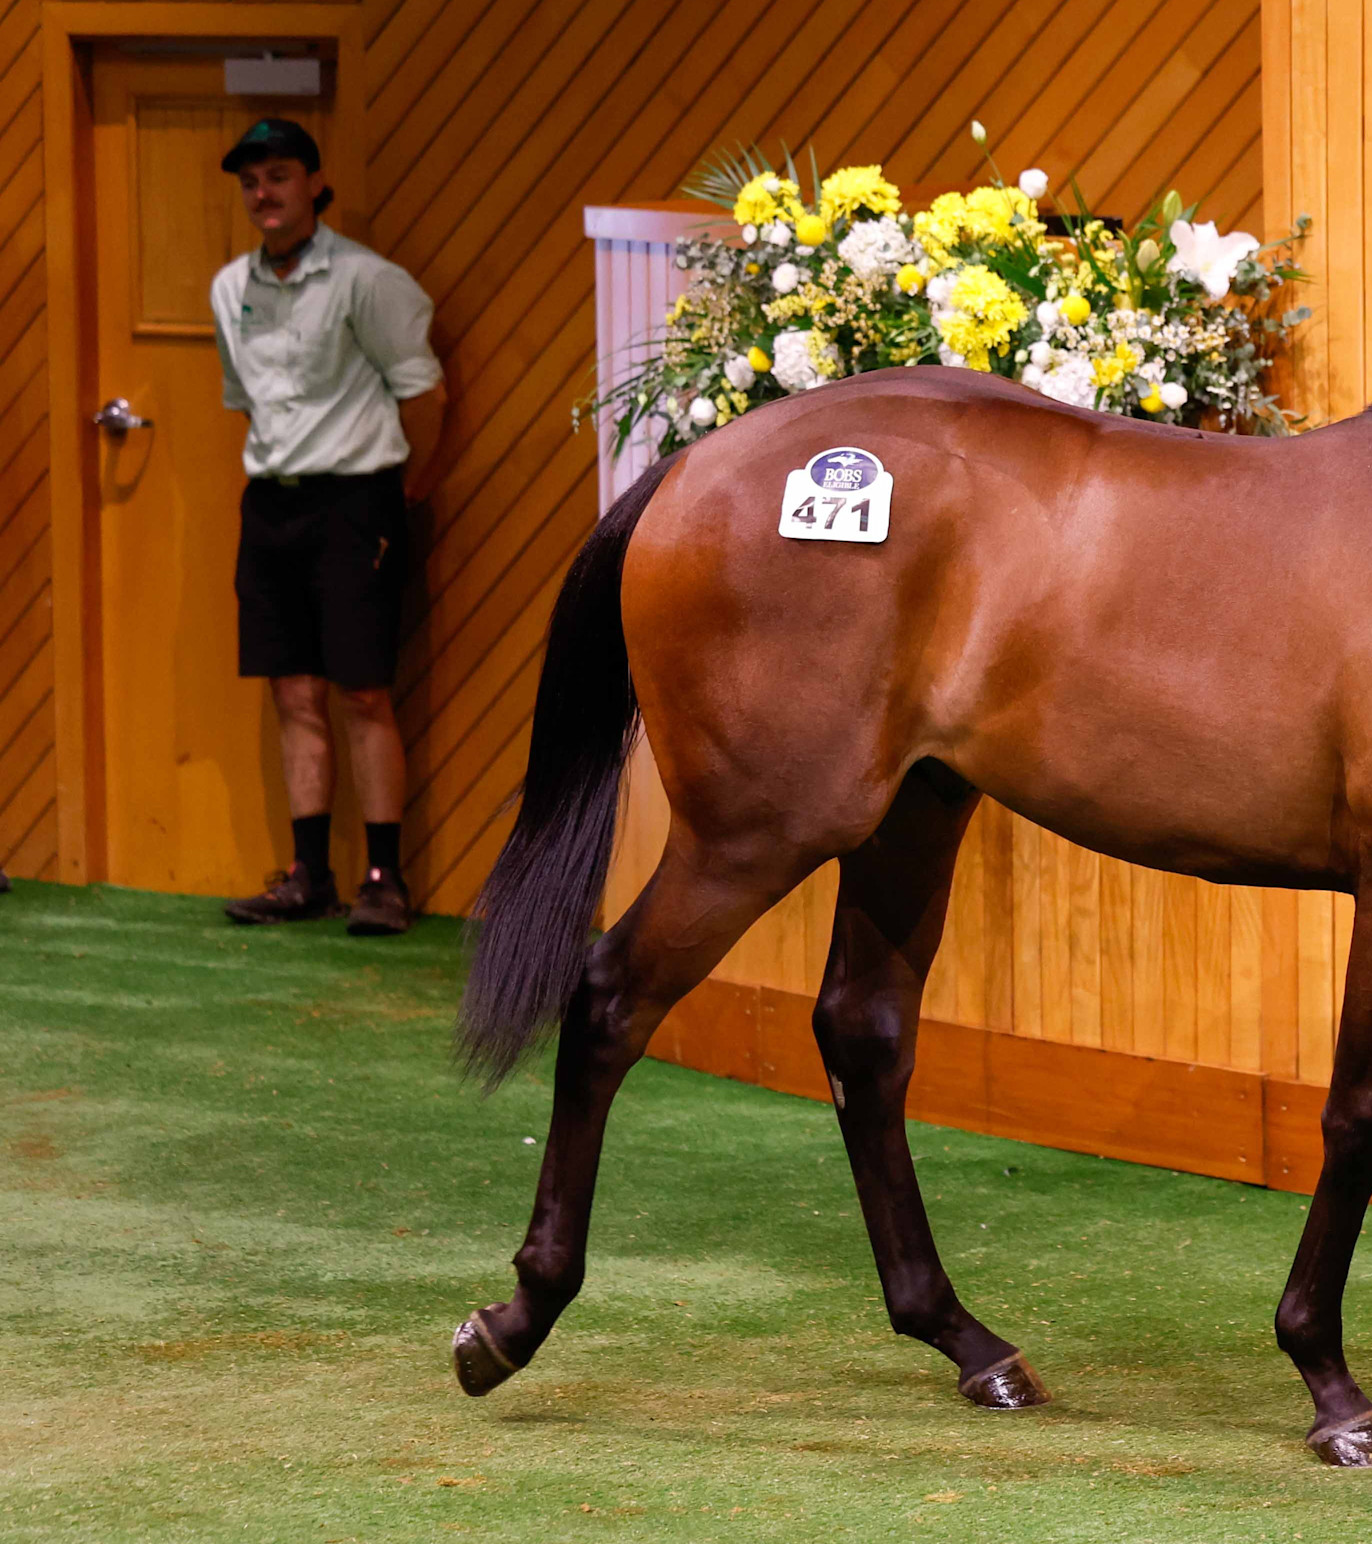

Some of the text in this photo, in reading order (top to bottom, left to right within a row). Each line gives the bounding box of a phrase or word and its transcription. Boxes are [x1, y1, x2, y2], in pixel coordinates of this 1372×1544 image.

[824, 467, 863, 482] BOBS
[822, 481, 860, 490] ELIGIBLE
[791, 496, 871, 532] 471
